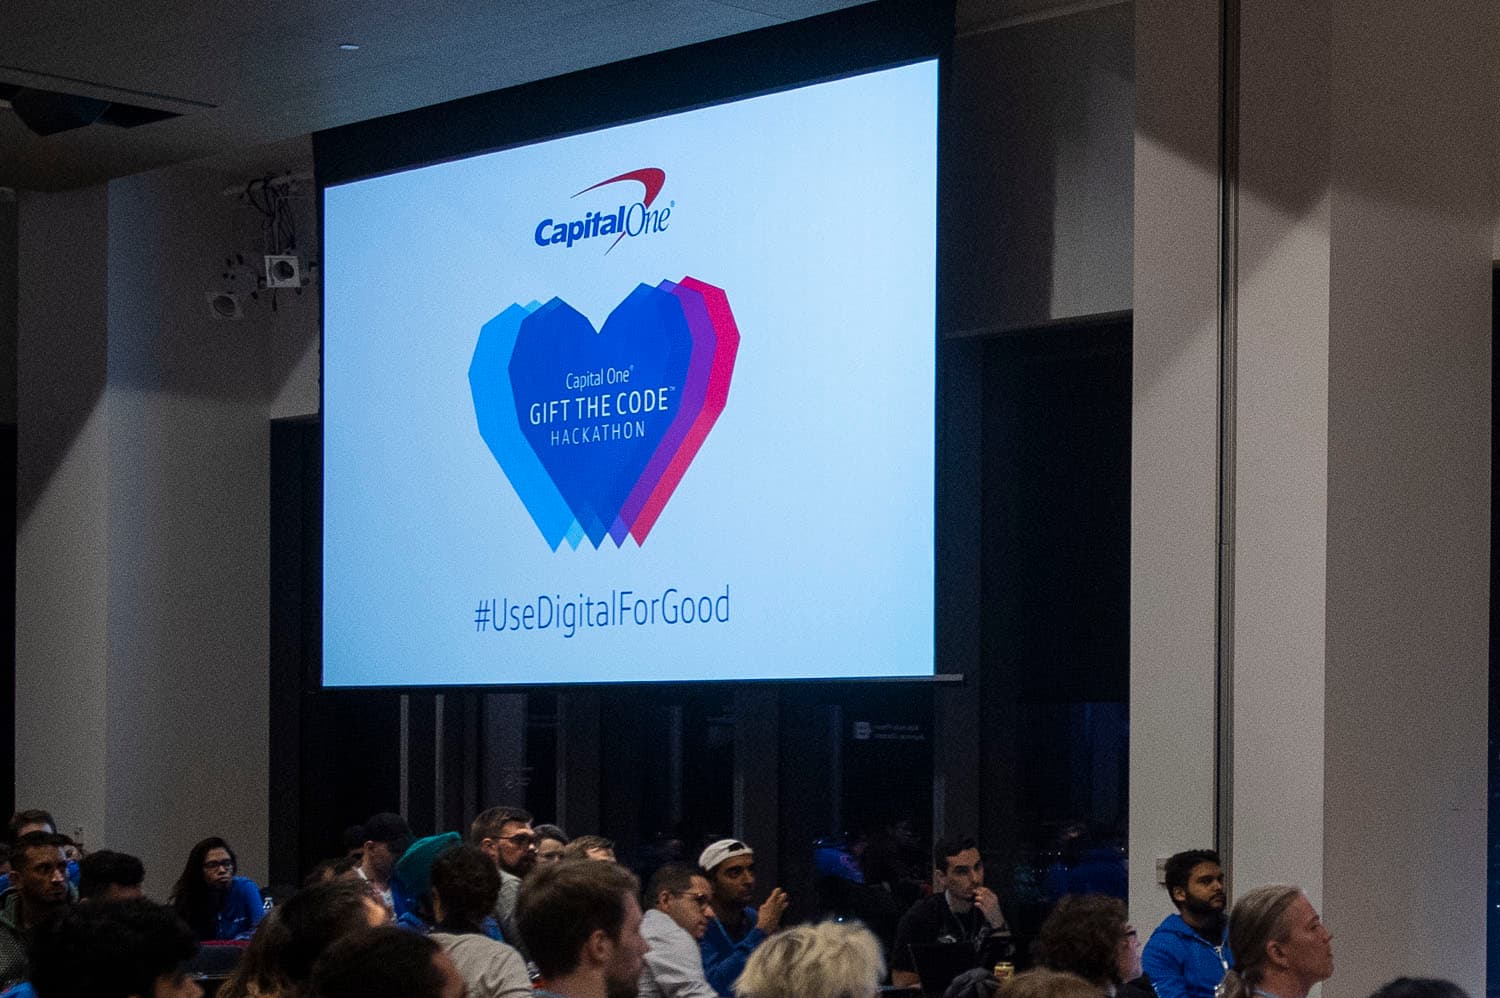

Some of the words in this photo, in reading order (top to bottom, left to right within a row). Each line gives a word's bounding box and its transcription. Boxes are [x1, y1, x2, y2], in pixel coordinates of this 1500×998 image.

[566, 368, 604, 392] Capital
[530, 399, 570, 425] GIFT
[575, 394, 611, 420] THE
[616, 387, 668, 415] CODE
[551, 420, 645, 446] HACKATHON
[474, 584, 730, 639] #UseDigitalForGood
